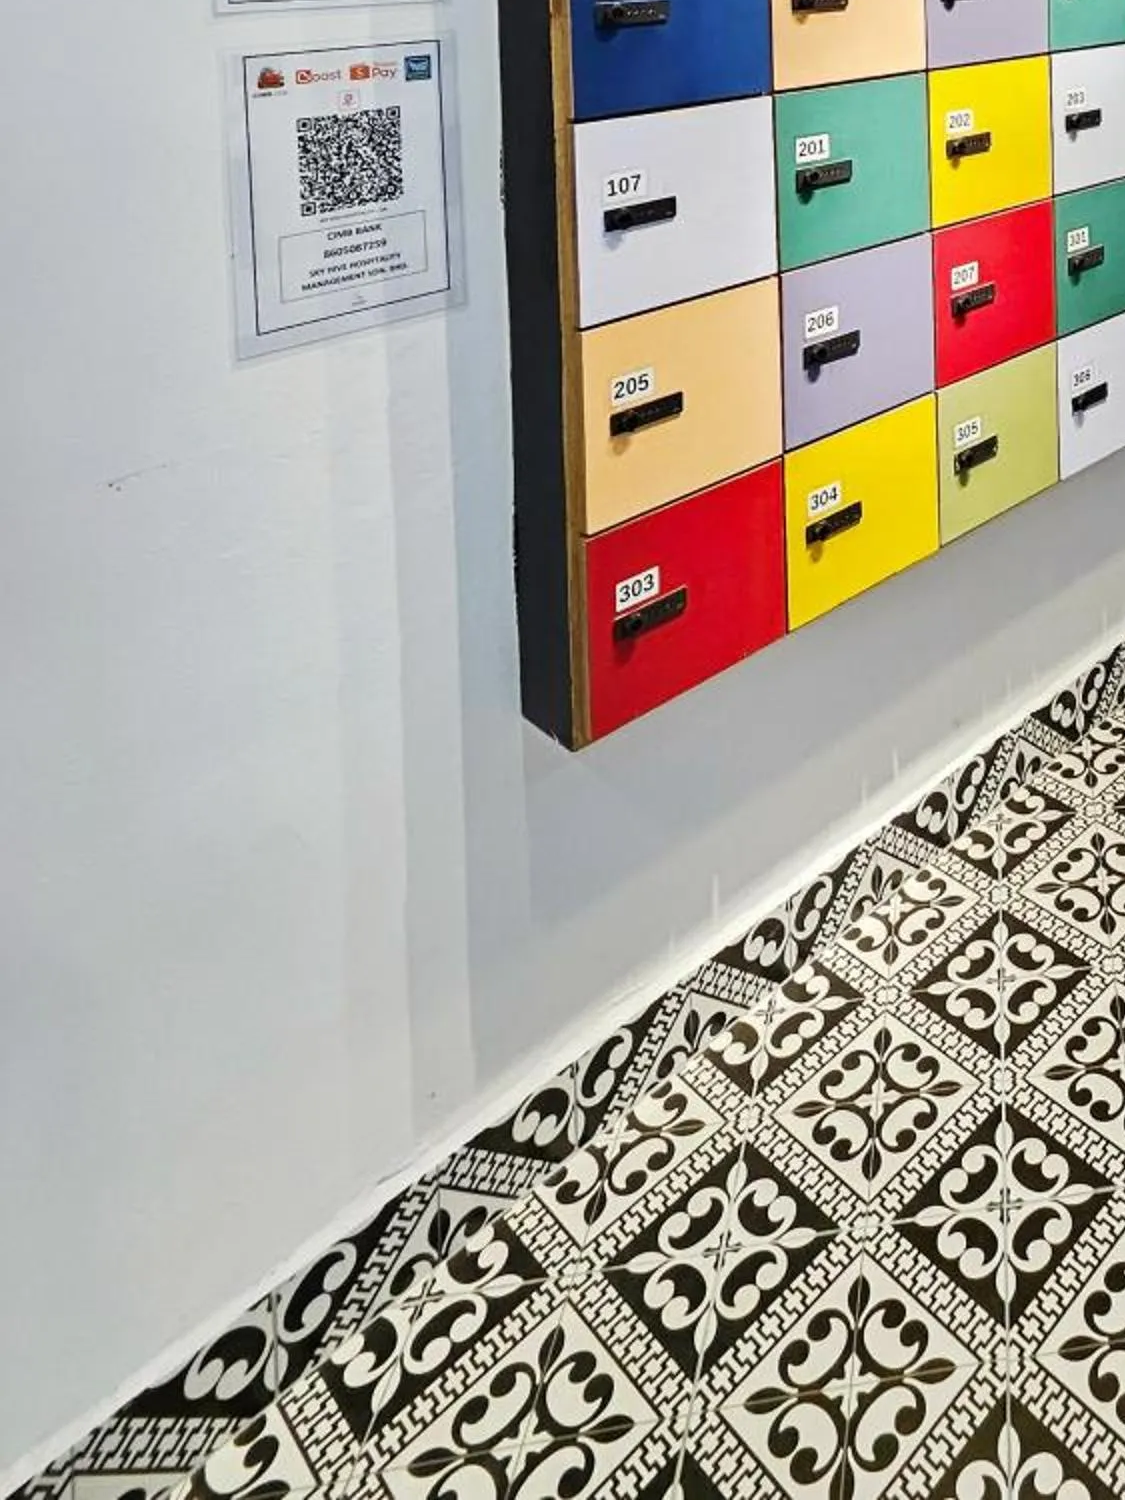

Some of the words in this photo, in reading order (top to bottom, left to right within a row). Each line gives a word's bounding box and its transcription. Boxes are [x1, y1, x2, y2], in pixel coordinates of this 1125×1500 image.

[371, 66, 398, 80] Pay
[1066, 91, 1086, 106] 203
[948, 113, 972, 129] 202
[798, 140, 827, 157] 201
[605, 175, 642, 195] 107
[327, 228, 354, 241] CIMB
[355, 223, 383, 235] BANK
[952, 267, 976, 285] 207
[807, 311, 836, 331] 206
[613, 373, 650, 399] 205
[956, 421, 980, 440] 305
[810, 487, 839, 509] 304
[618, 573, 656, 603] 303
